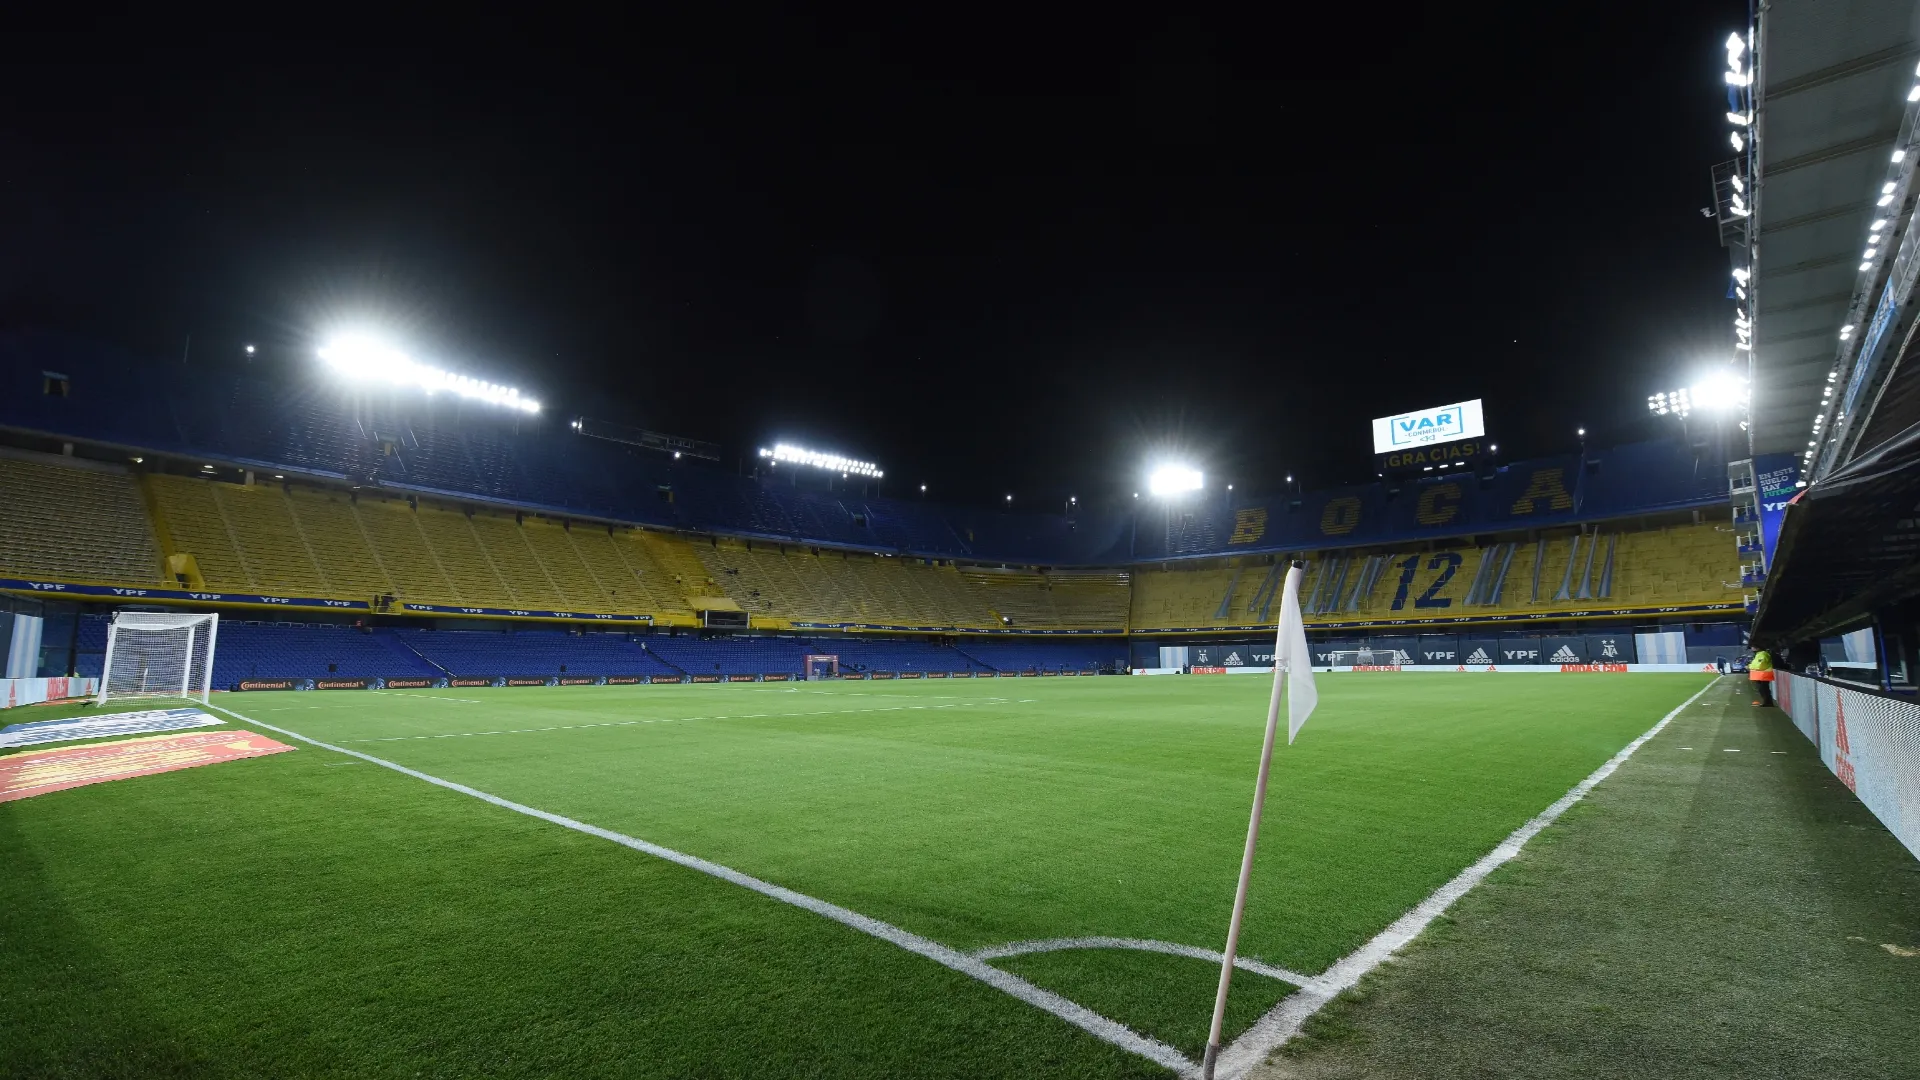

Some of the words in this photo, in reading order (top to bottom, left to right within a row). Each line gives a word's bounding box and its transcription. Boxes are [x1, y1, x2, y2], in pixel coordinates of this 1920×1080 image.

[1400, 414, 1453, 431] VAR
[1758, 472, 1771, 480] EN
[1773, 467, 1794, 476] ESTE
[1760, 475, 1789, 486] SUELO
[1762, 483, 1781, 493] HAY
[1763, 502, 1787, 511] YP
[1390, 552, 1463, 610] 12
[29, 582, 66, 590] YPF
[112, 588, 147, 596] YPF
[1317, 653, 1344, 661] YPF
[1424, 652, 1455, 660] YPF
[1504, 650, 1538, 659] YPF
[241, 682, 286, 690] Continental
[318, 681, 359, 689] Continental
